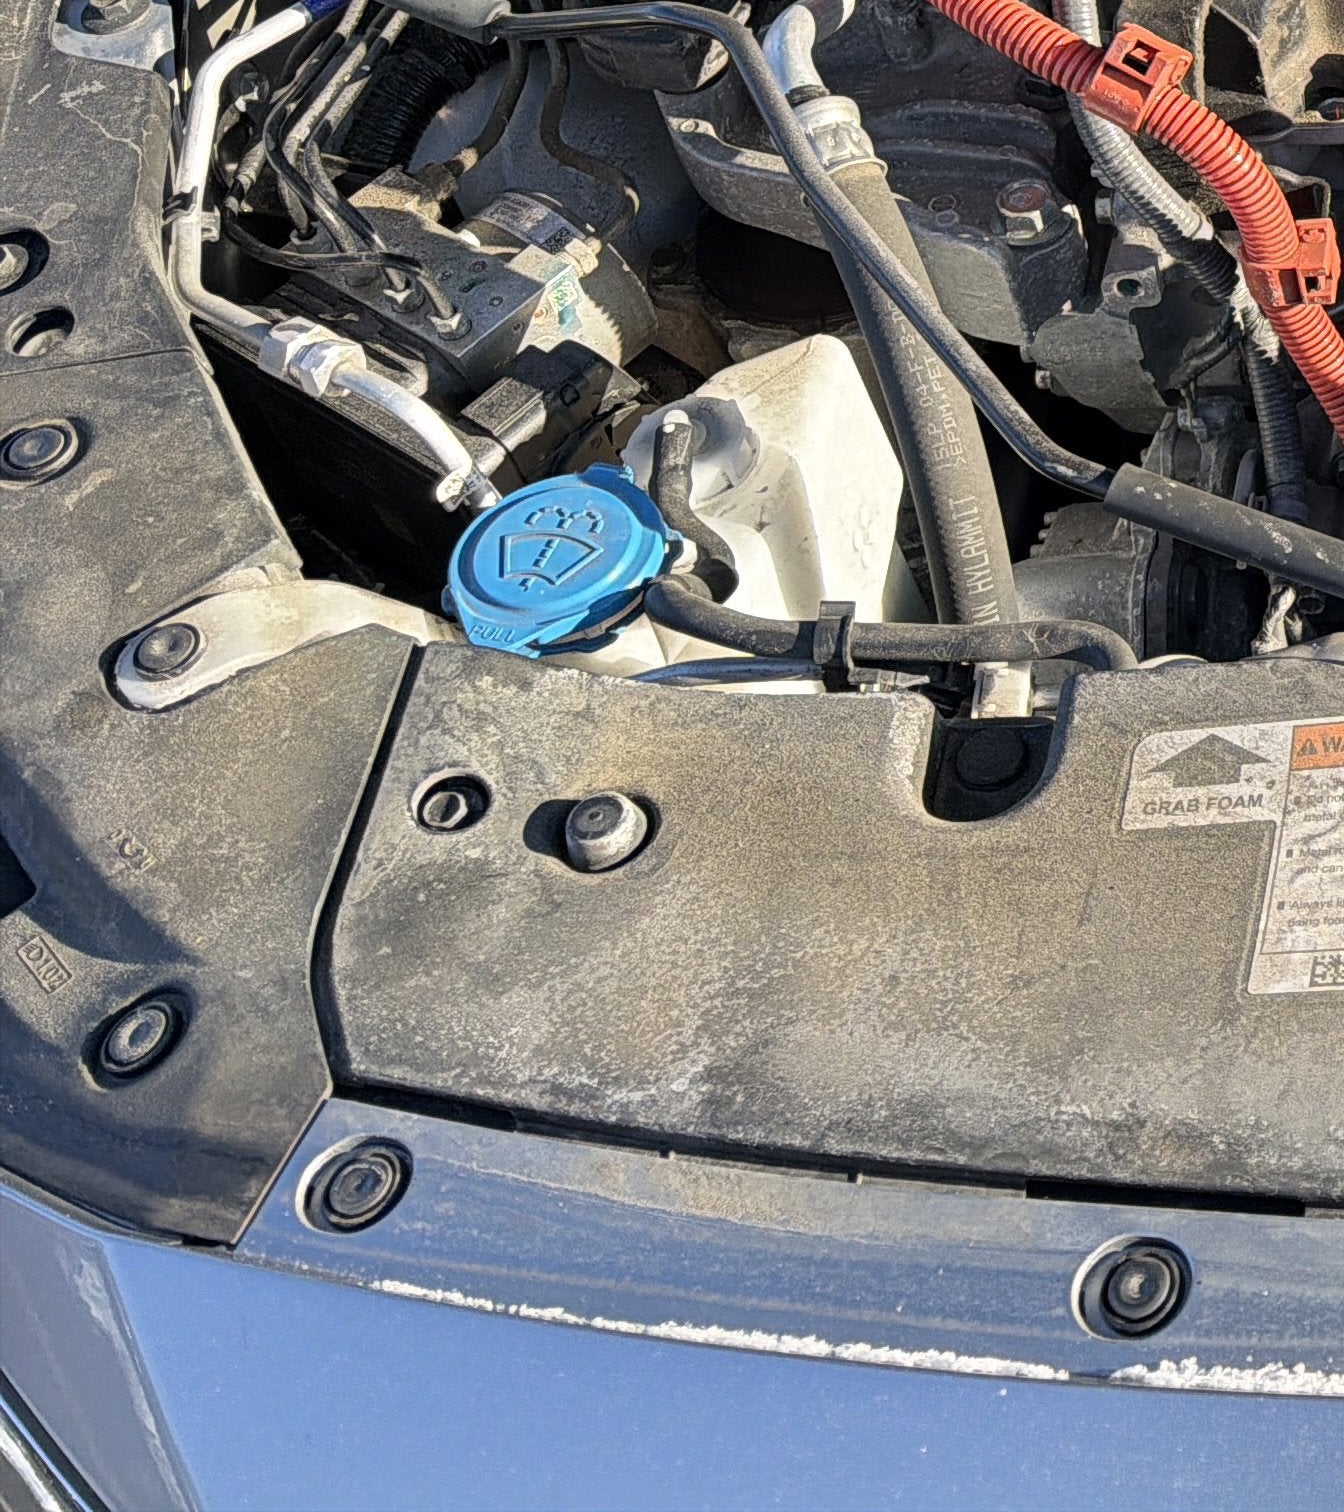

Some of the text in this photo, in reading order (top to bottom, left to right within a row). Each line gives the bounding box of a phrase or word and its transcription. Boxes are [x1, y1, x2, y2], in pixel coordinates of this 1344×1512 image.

[470, 624, 516, 644] PULL
[1142, 793, 1264, 816] GRAB FOAM
[1300, 845, 1332, 857] Metal
[1297, 864, 1319, 874] and
[1321, 864, 1344, 873] can
[1288, 899, 1333, 911] Always
[1287, 916, 1320, 928] using
